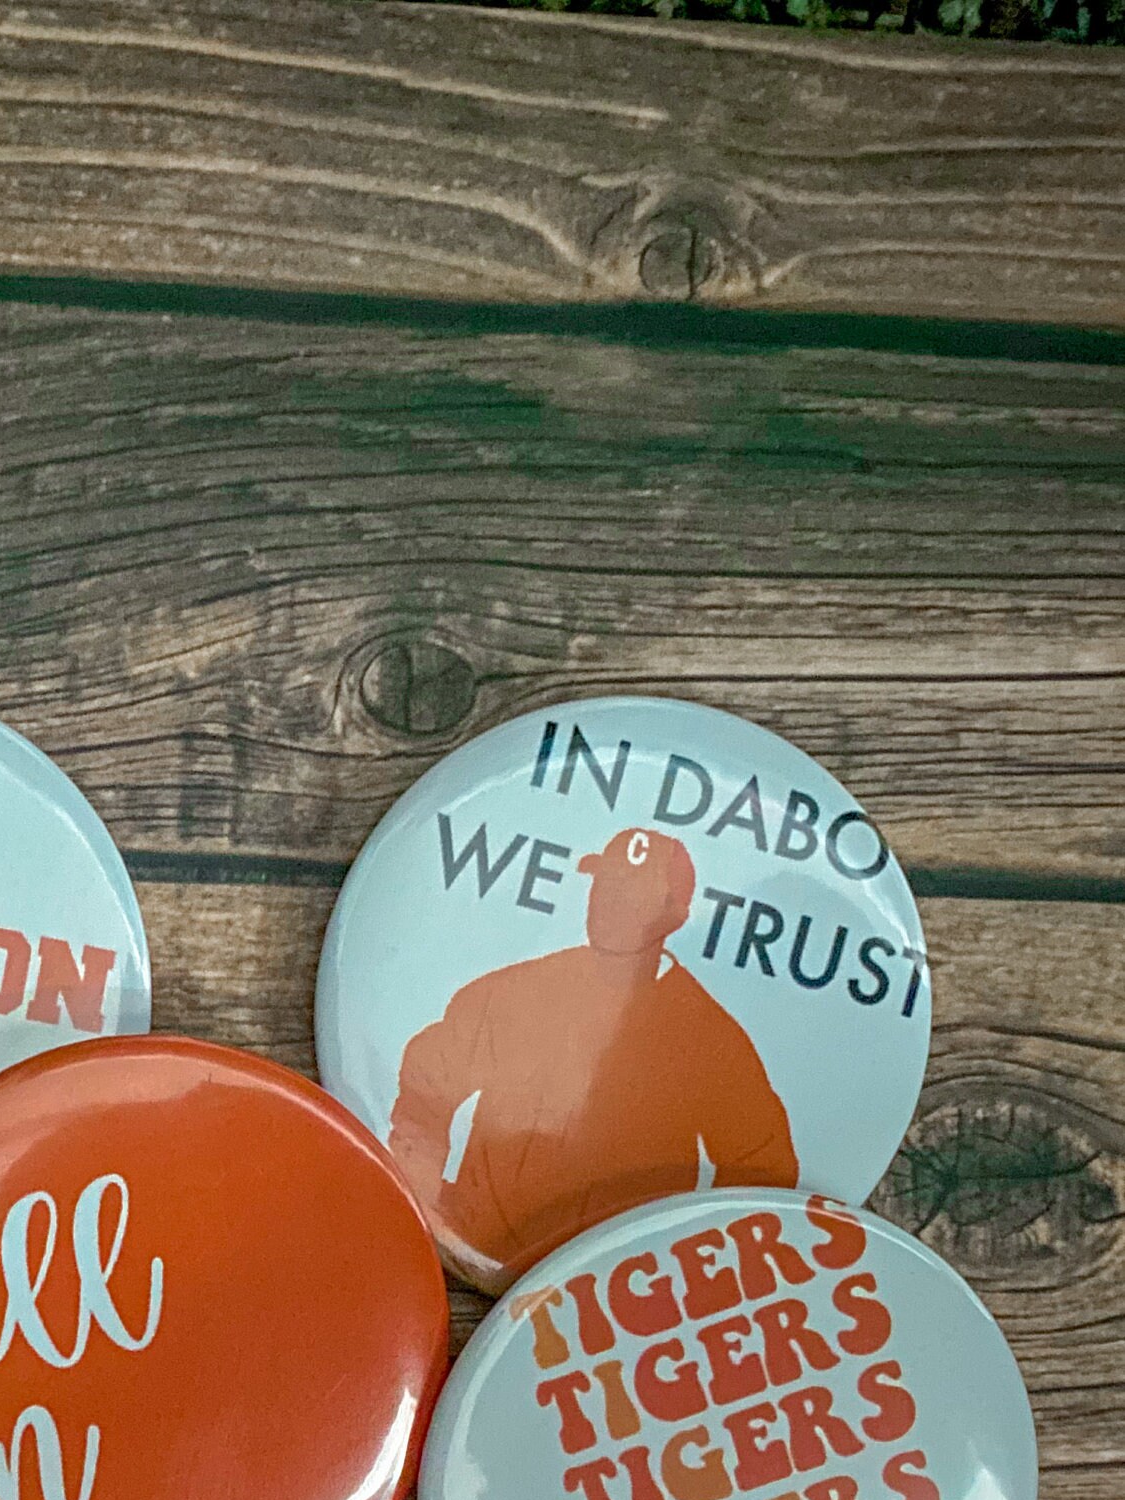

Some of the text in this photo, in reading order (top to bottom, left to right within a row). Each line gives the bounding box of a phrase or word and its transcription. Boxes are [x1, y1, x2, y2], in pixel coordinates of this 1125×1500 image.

[529, 720, 890, 881] IN DABO
[626, 831, 650, 866] C
[436, 812, 928, 1019] WE TRUST
[509, 1193, 868, 1371] TIGERS
[535, 1272, 893, 1455] TIGERS
